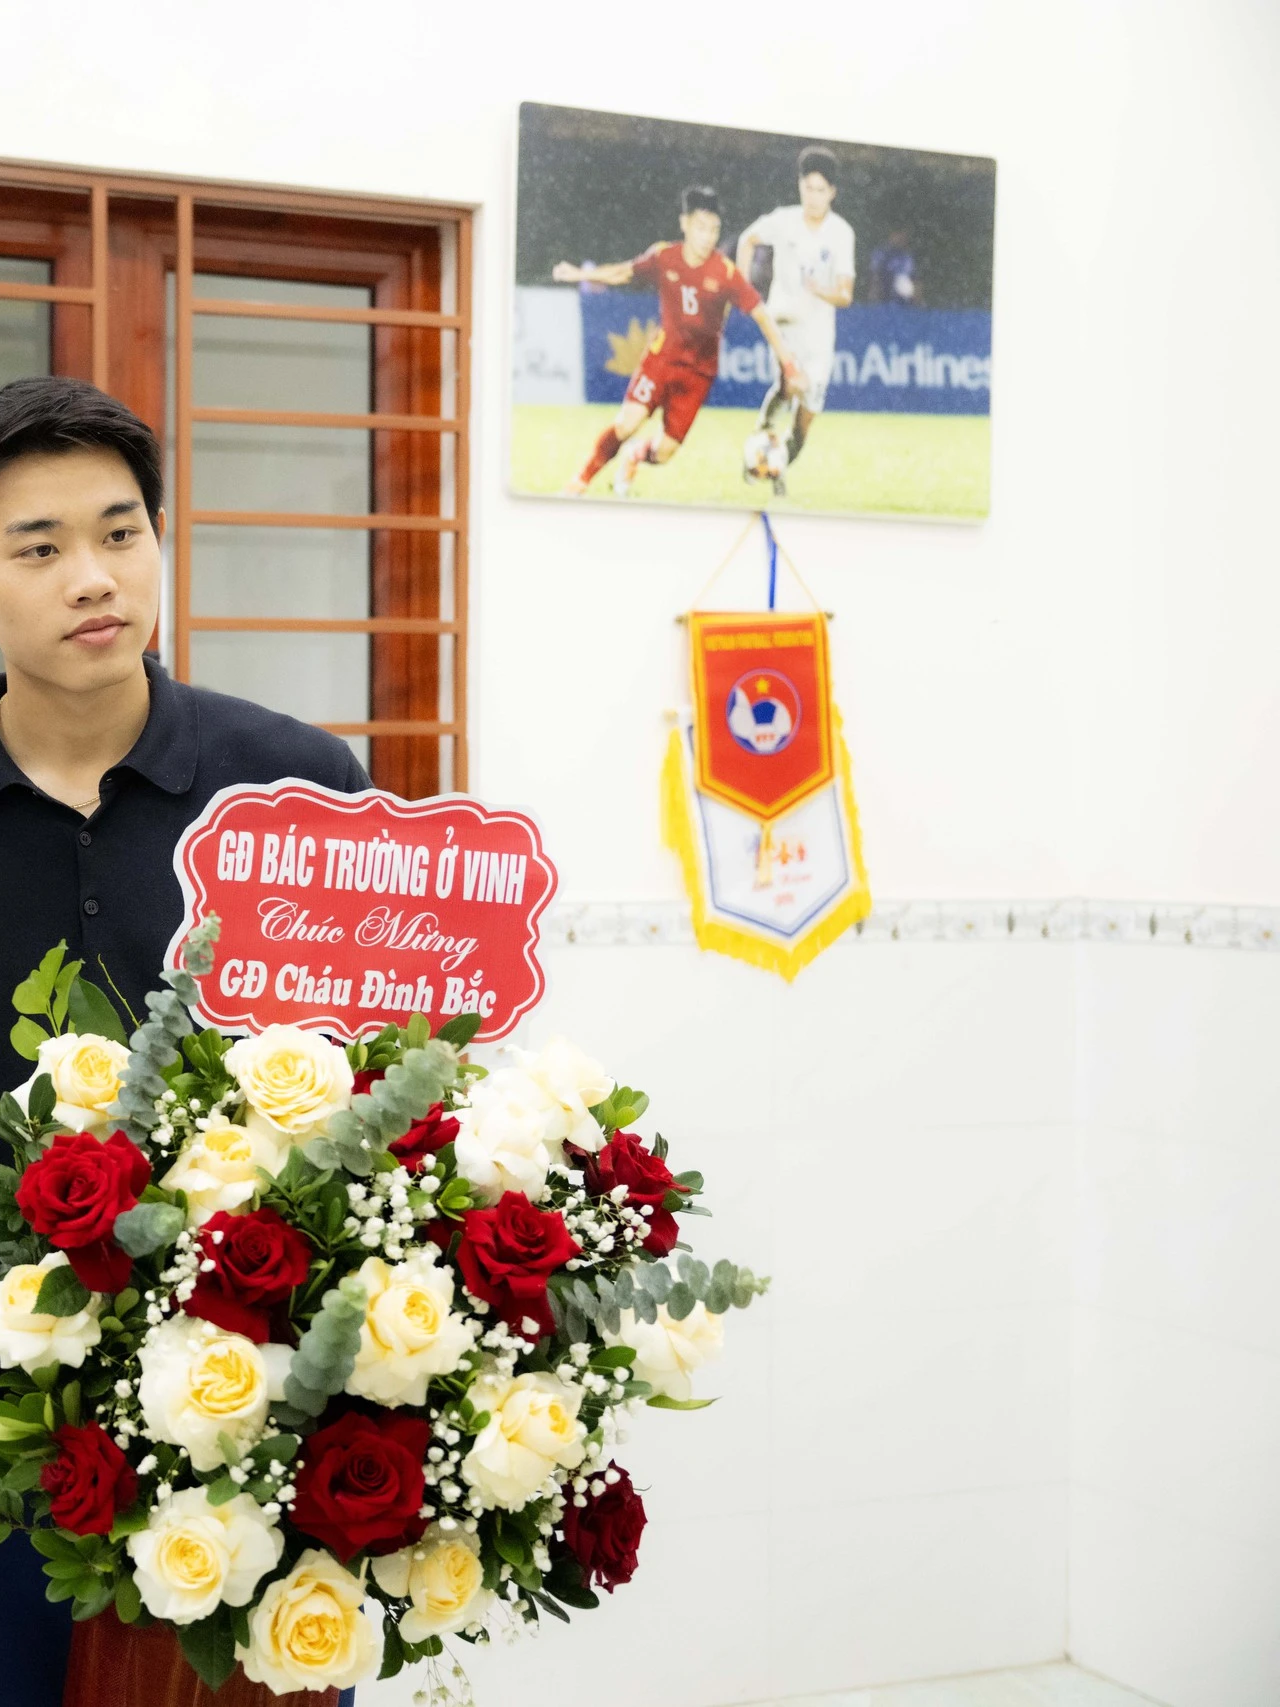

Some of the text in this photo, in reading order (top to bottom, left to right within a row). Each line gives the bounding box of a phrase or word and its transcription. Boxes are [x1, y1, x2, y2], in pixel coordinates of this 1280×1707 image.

[681, 285, 699, 315] 15
[217, 824, 528, 905] GĐ BÁC TRƯỜNG Ở VINH
[257, 897, 480, 972] Chúc Mừng
[220, 958, 497, 1018] GĐ Cháu Đình Bắc
